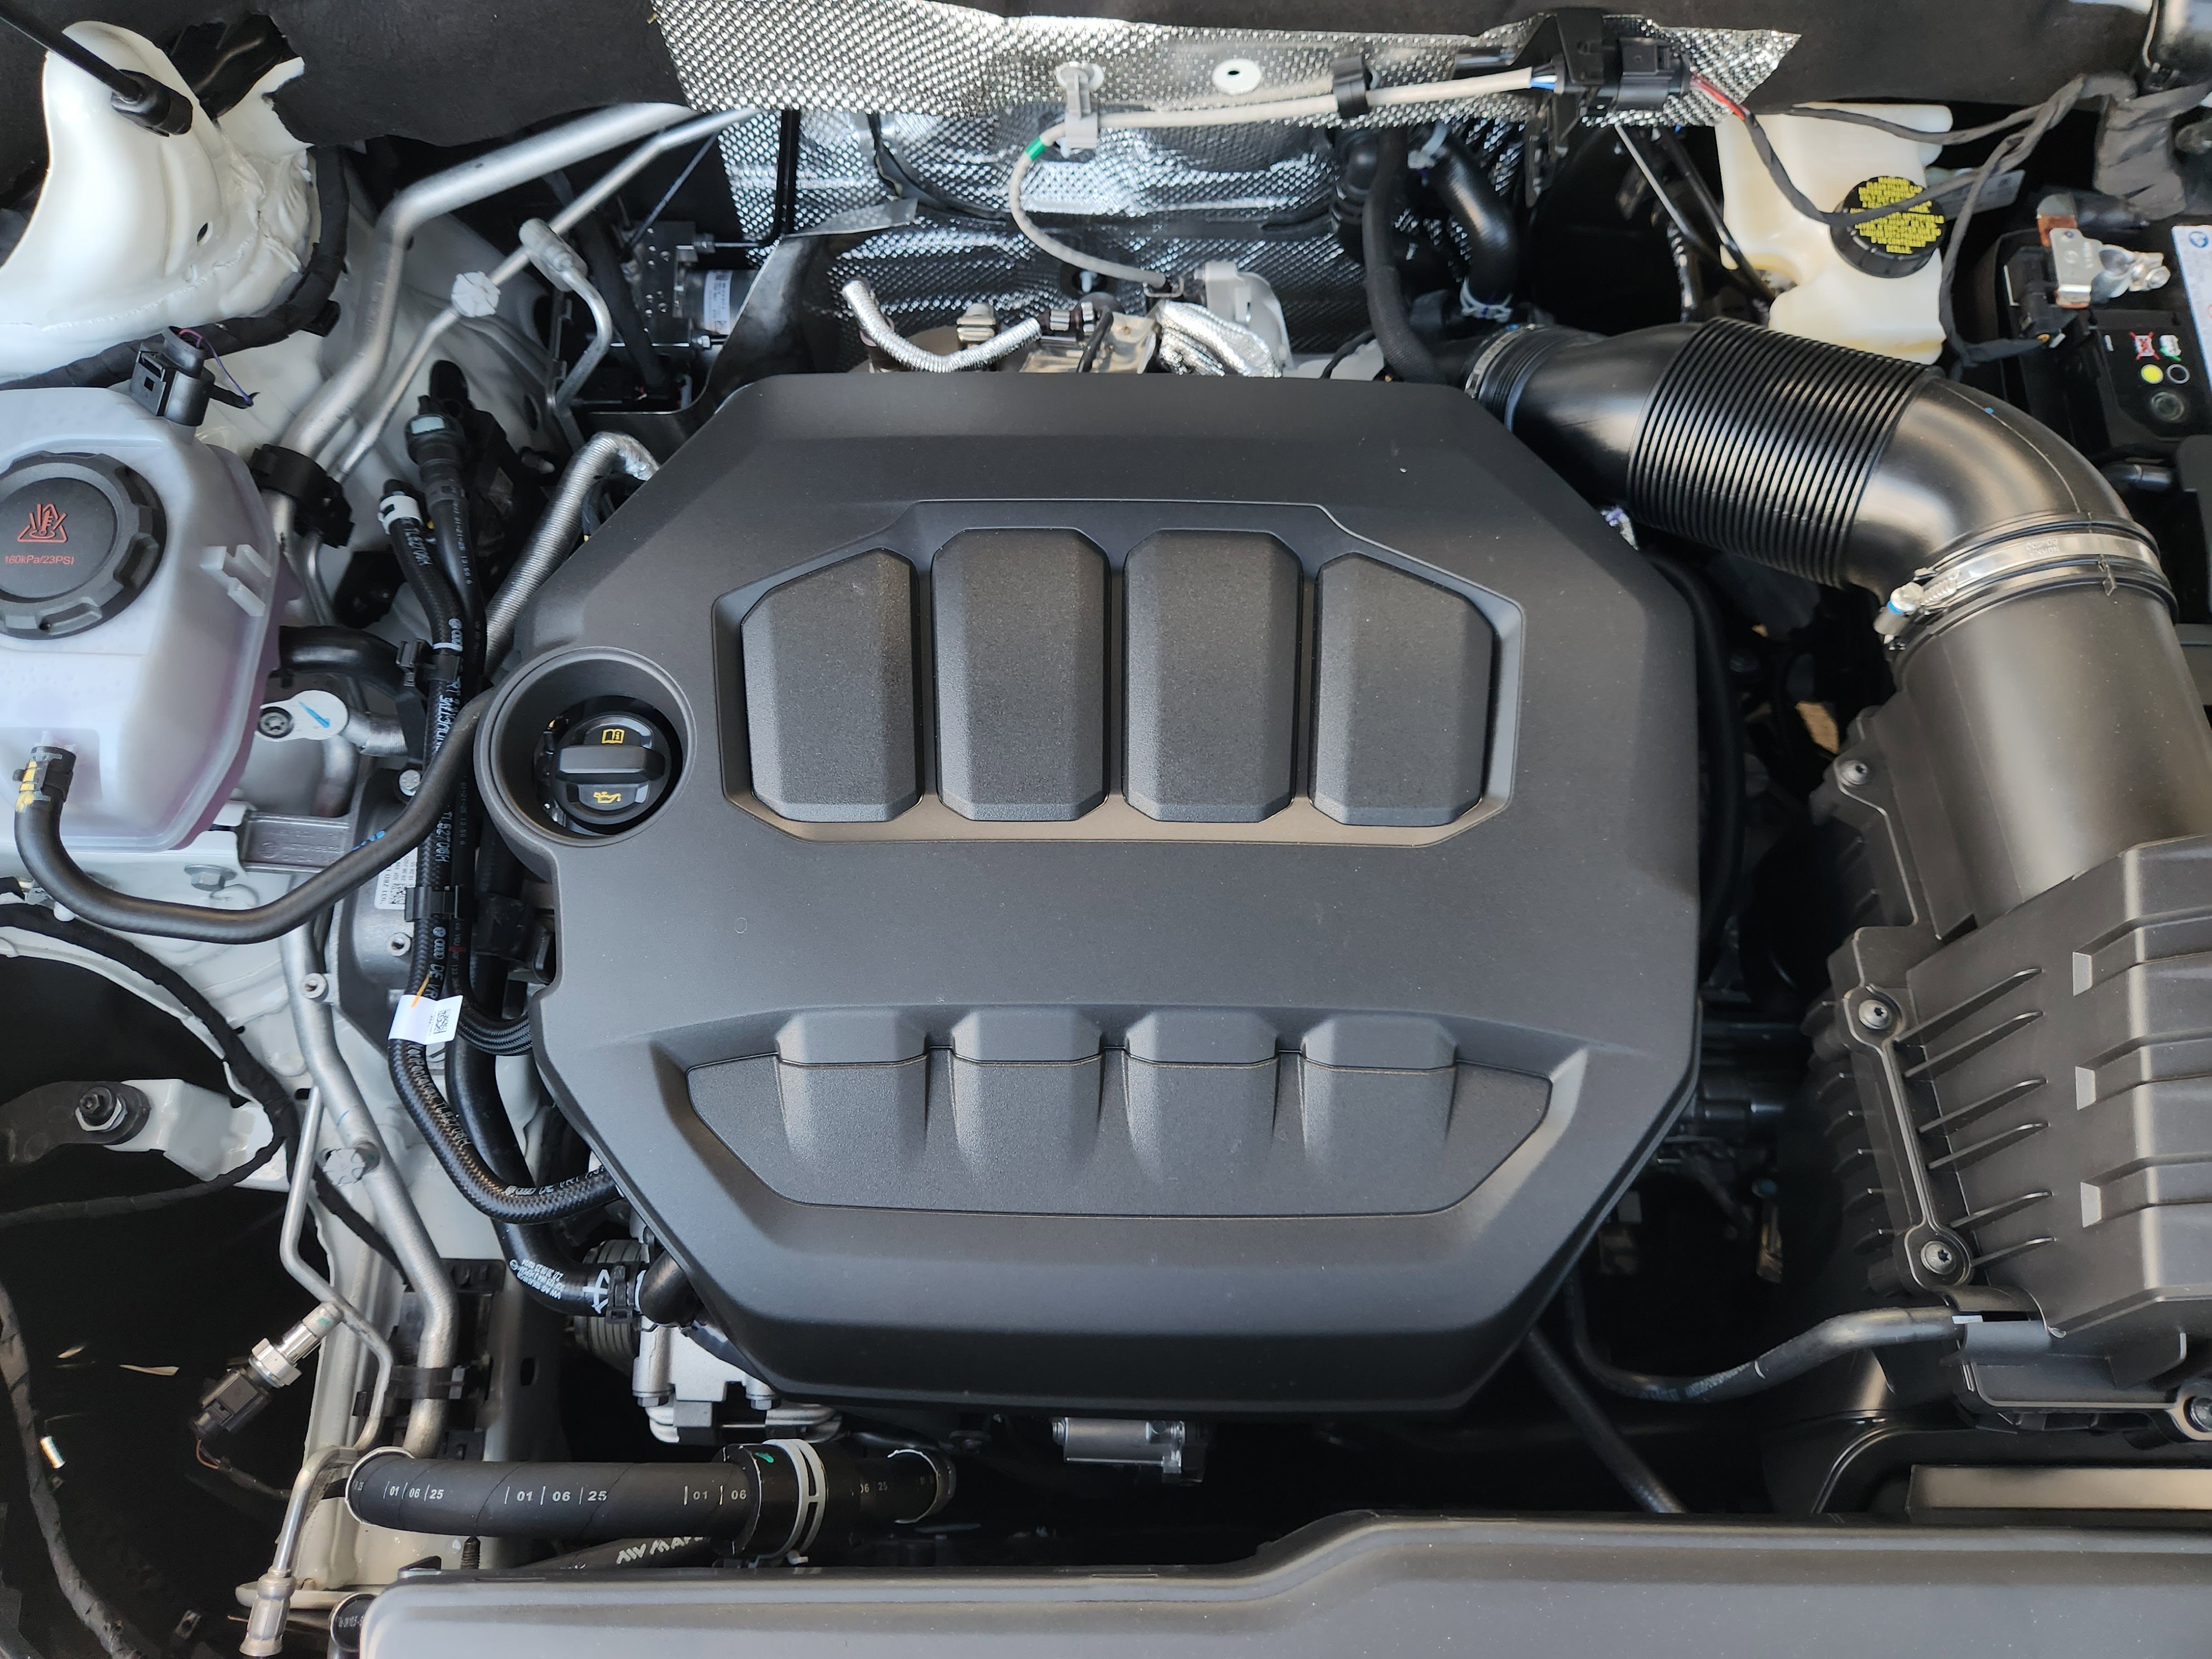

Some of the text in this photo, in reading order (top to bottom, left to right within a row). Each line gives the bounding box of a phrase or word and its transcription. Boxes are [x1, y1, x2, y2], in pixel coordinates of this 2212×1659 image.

[4, 555, 74, 565] 160kPa/23PSI
[409, 1488, 421, 1499] 06
[429, 1489, 445, 1499] 25
[517, 1490, 608, 1502] 01 06 25
[693, 1489, 747, 1500] 01 06
